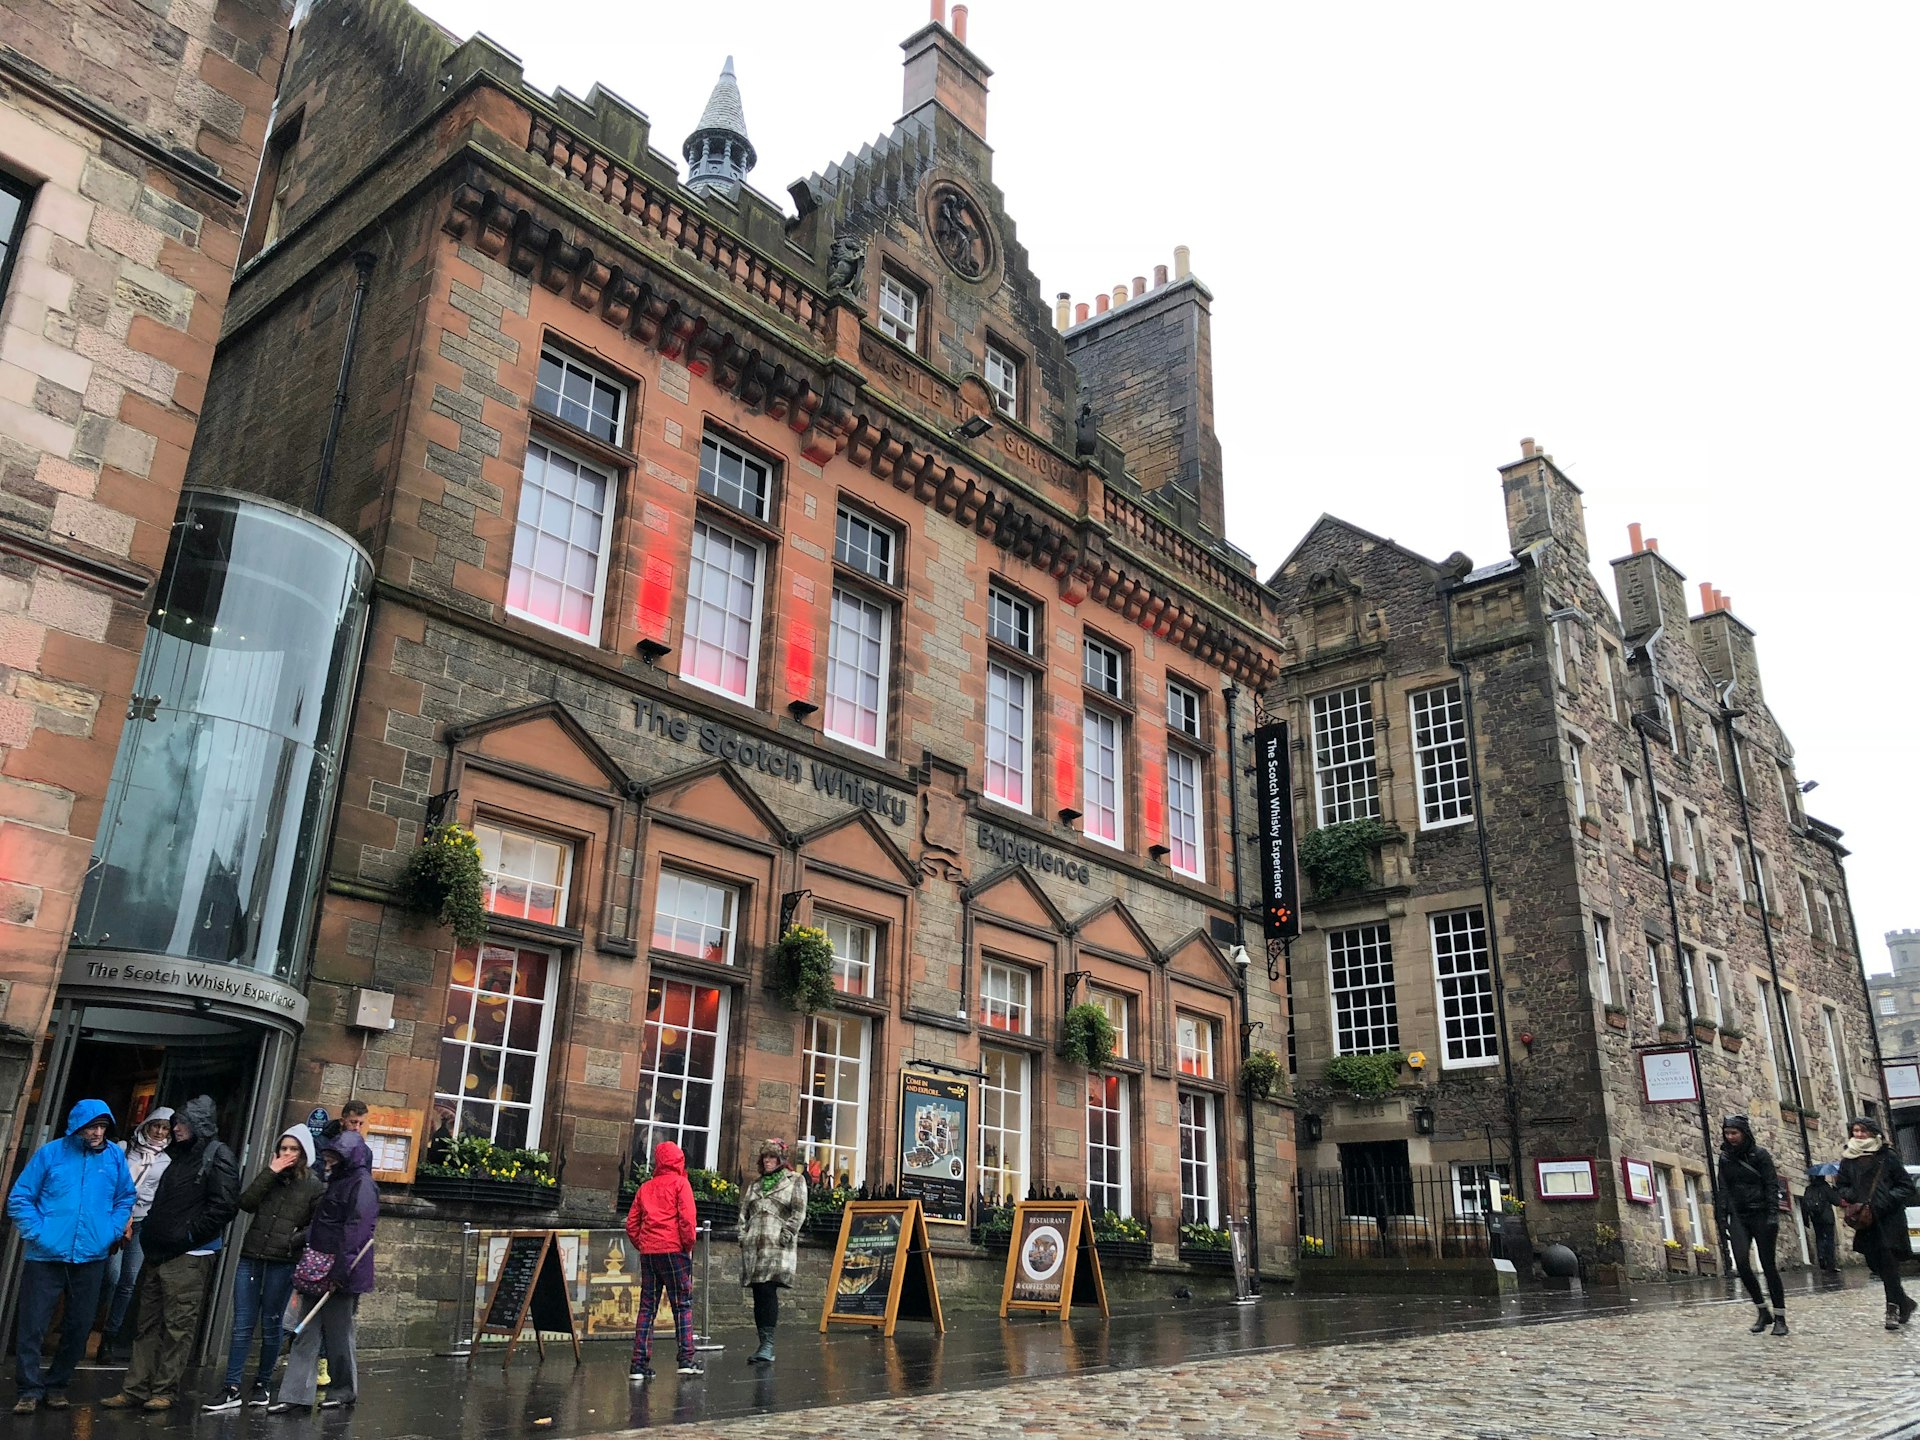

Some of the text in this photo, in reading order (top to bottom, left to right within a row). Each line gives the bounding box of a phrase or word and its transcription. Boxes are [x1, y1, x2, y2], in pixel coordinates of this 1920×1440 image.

[862, 343, 1070, 489] CASTLE HIL SCHOOL
[632, 699, 1090, 885] The Scotch Whisky Experience
[1267, 737, 1284, 899] The Scotch Whisky Experience
[87, 962, 296, 1009] The Scotch Whisky Experience
[1044, 1283, 1060, 1291] SHOP
